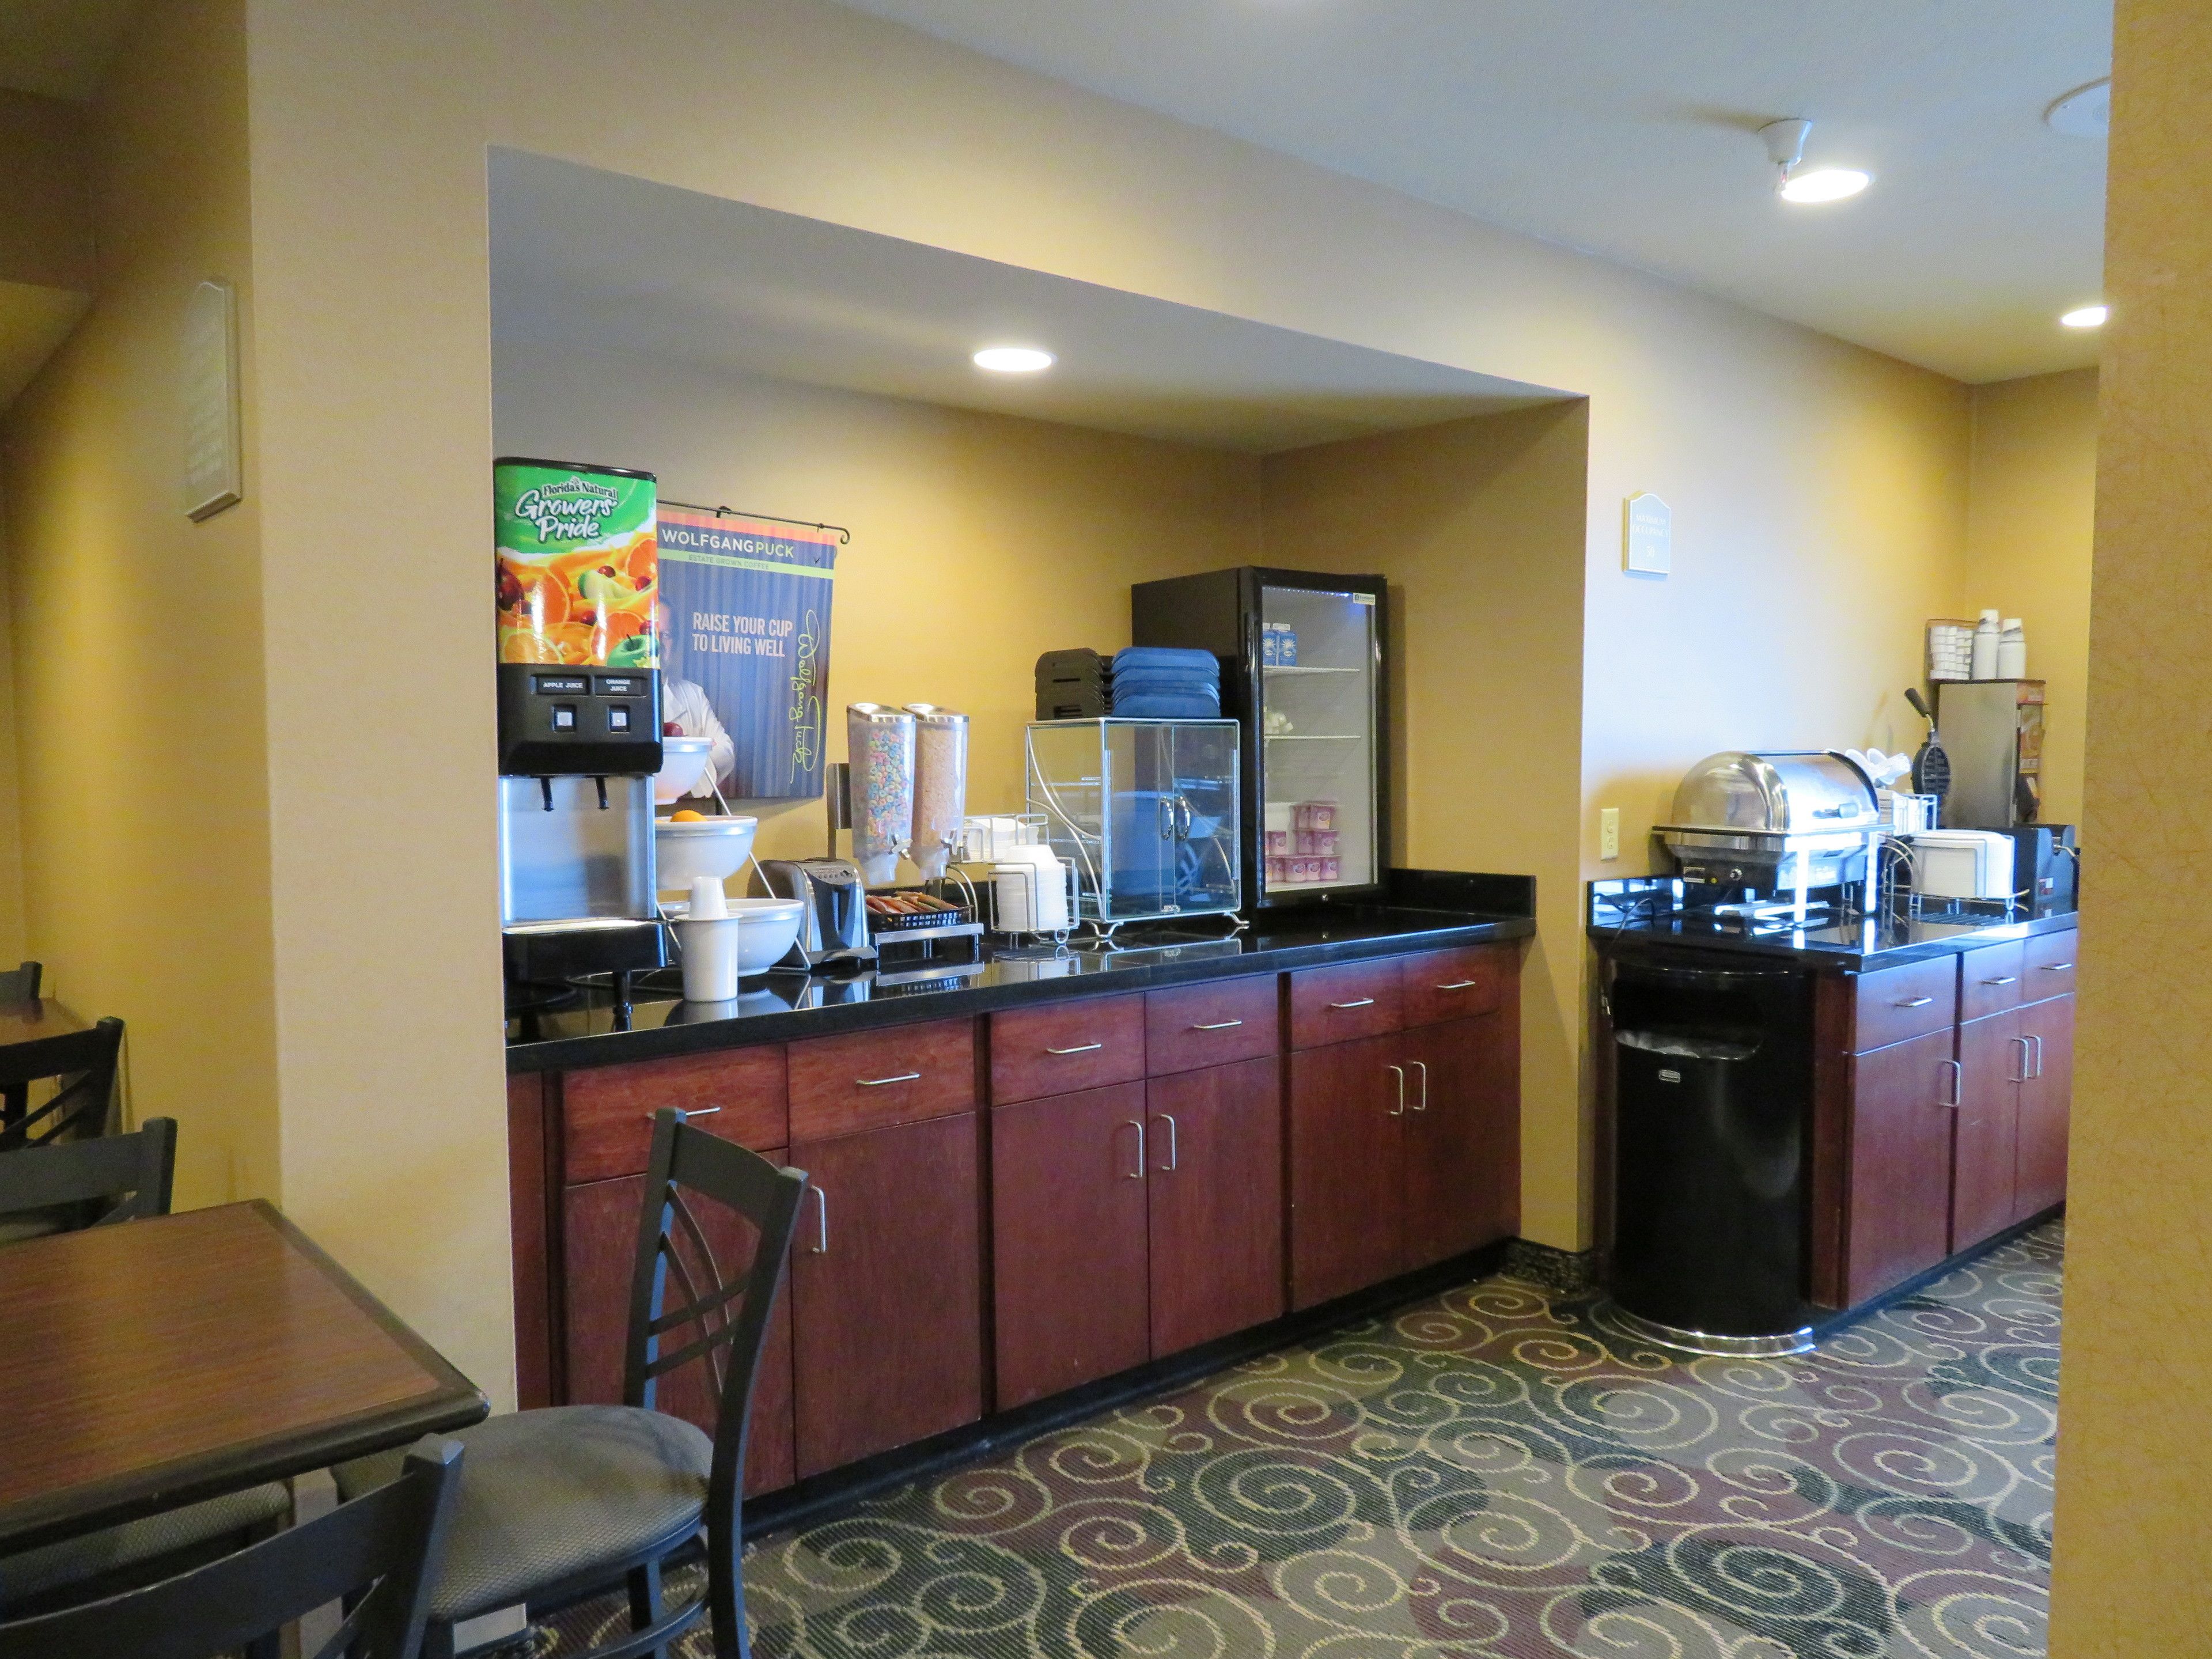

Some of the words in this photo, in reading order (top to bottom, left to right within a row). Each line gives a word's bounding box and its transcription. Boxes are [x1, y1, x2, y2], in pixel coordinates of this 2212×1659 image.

[543, 483, 580, 495] Florida's
[535, 515, 599, 541] Pride
[662, 529, 753, 553] WOLFGANG
[755, 541, 794, 558] PUCK
[689, 554, 714, 563] ESTATE
[716, 558, 742, 566] GROWN
[744, 561, 770, 570] COFFEE
[693, 612, 730, 632] RAISE
[733, 615, 766, 635] YOUR
[768, 619, 793, 637] CUP
[692, 633, 708, 652] TO
[711, 635, 751, 655] LIVING
[755, 638, 786, 657] WELL
